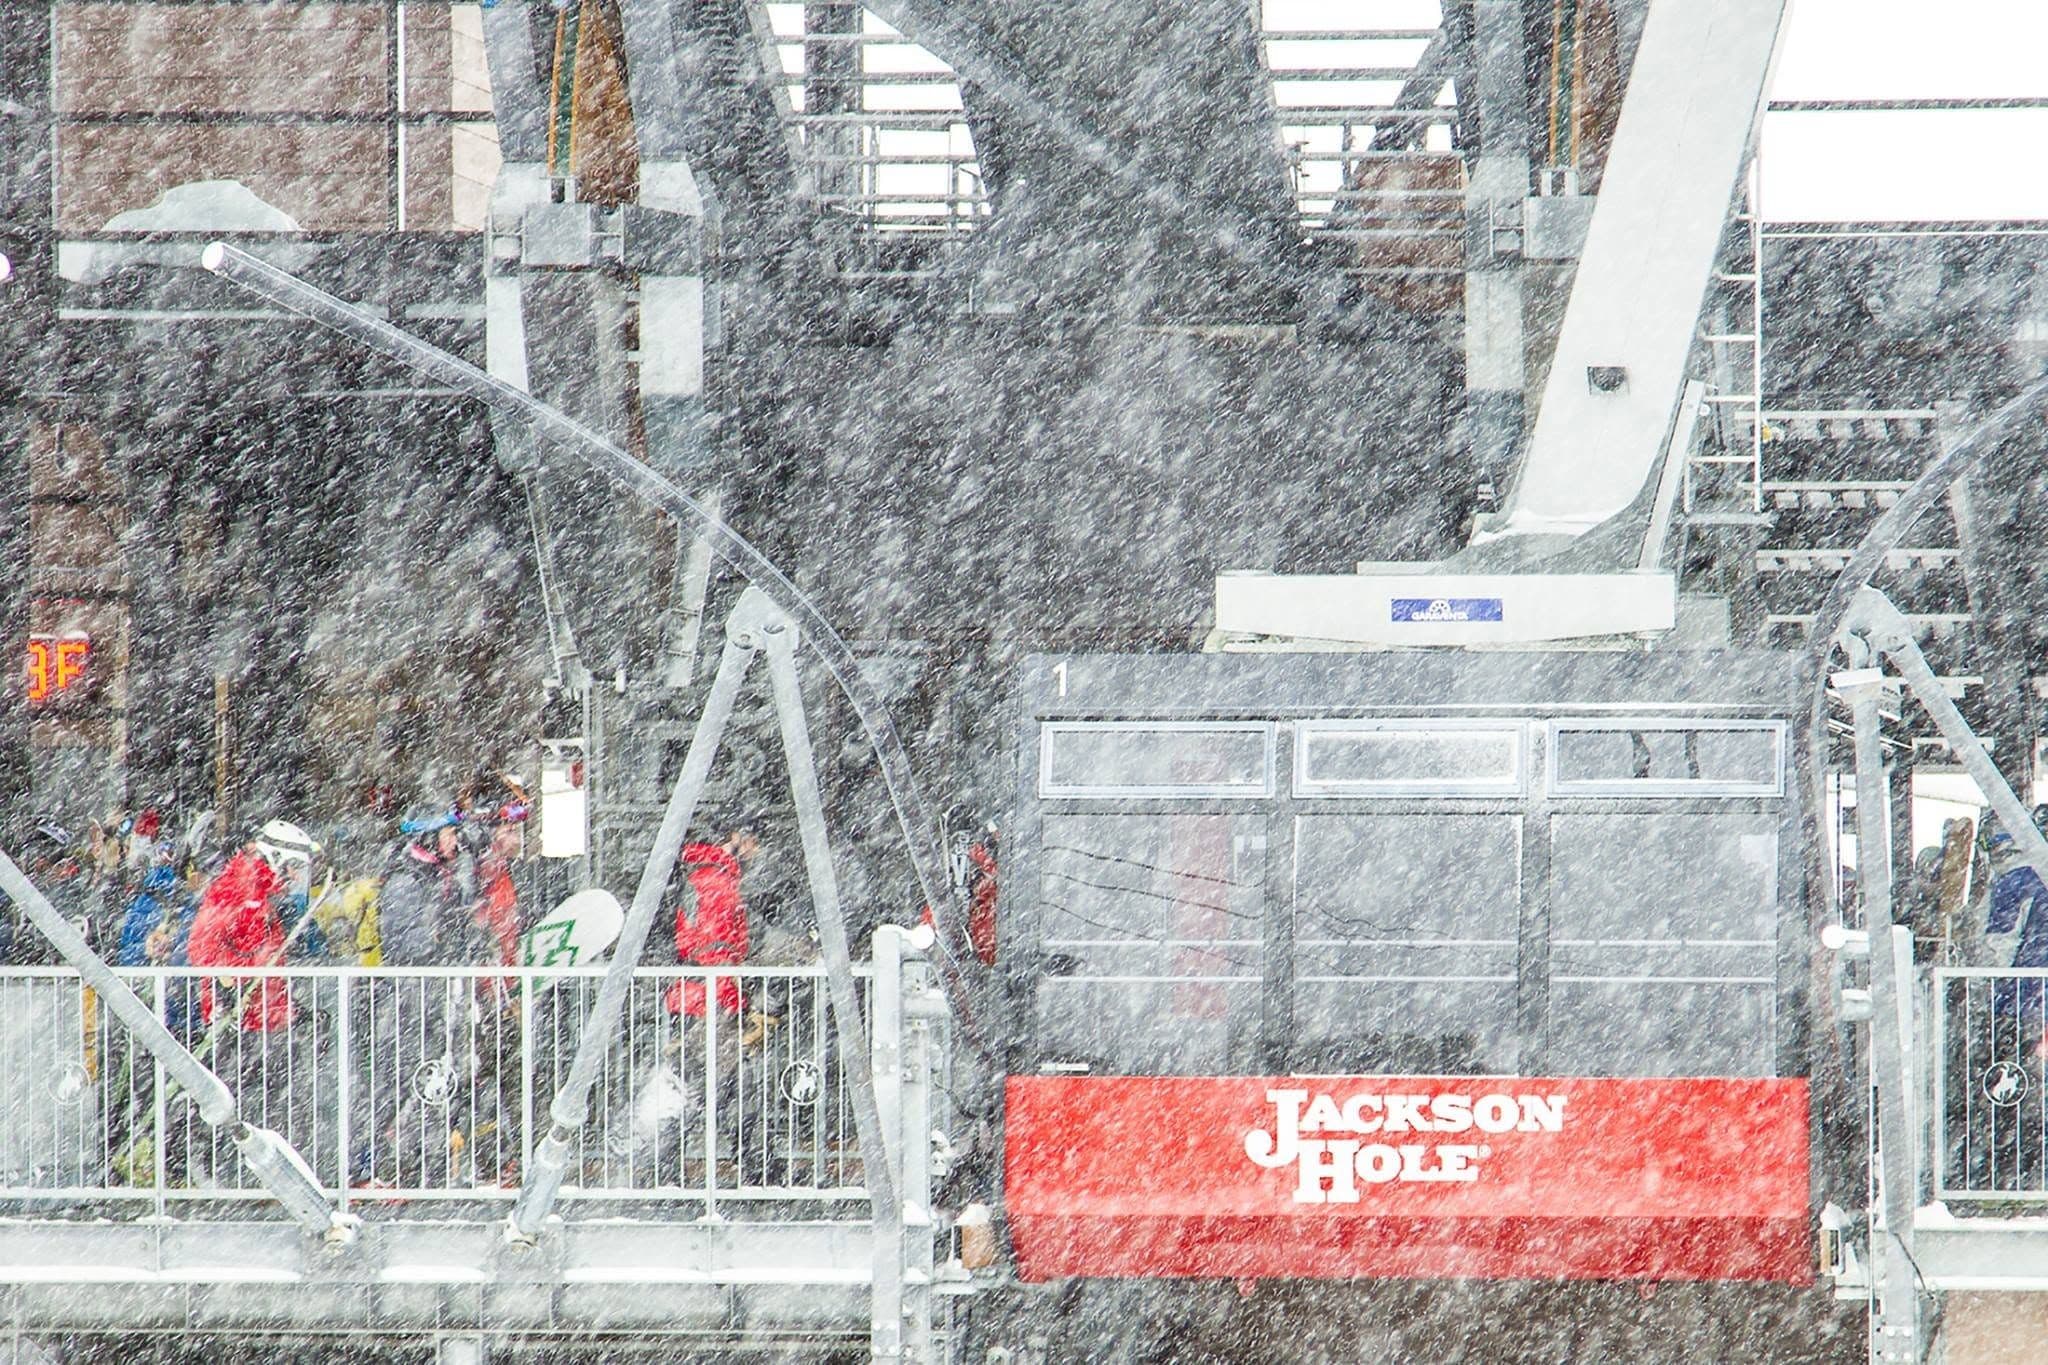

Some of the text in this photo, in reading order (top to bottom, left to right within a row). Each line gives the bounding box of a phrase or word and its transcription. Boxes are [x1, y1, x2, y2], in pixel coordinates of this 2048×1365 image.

[1052, 661, 1067, 697] 1
[1244, 1089, 1567, 1167] JACKSON
[1292, 1139, 1479, 1203] HOLE
